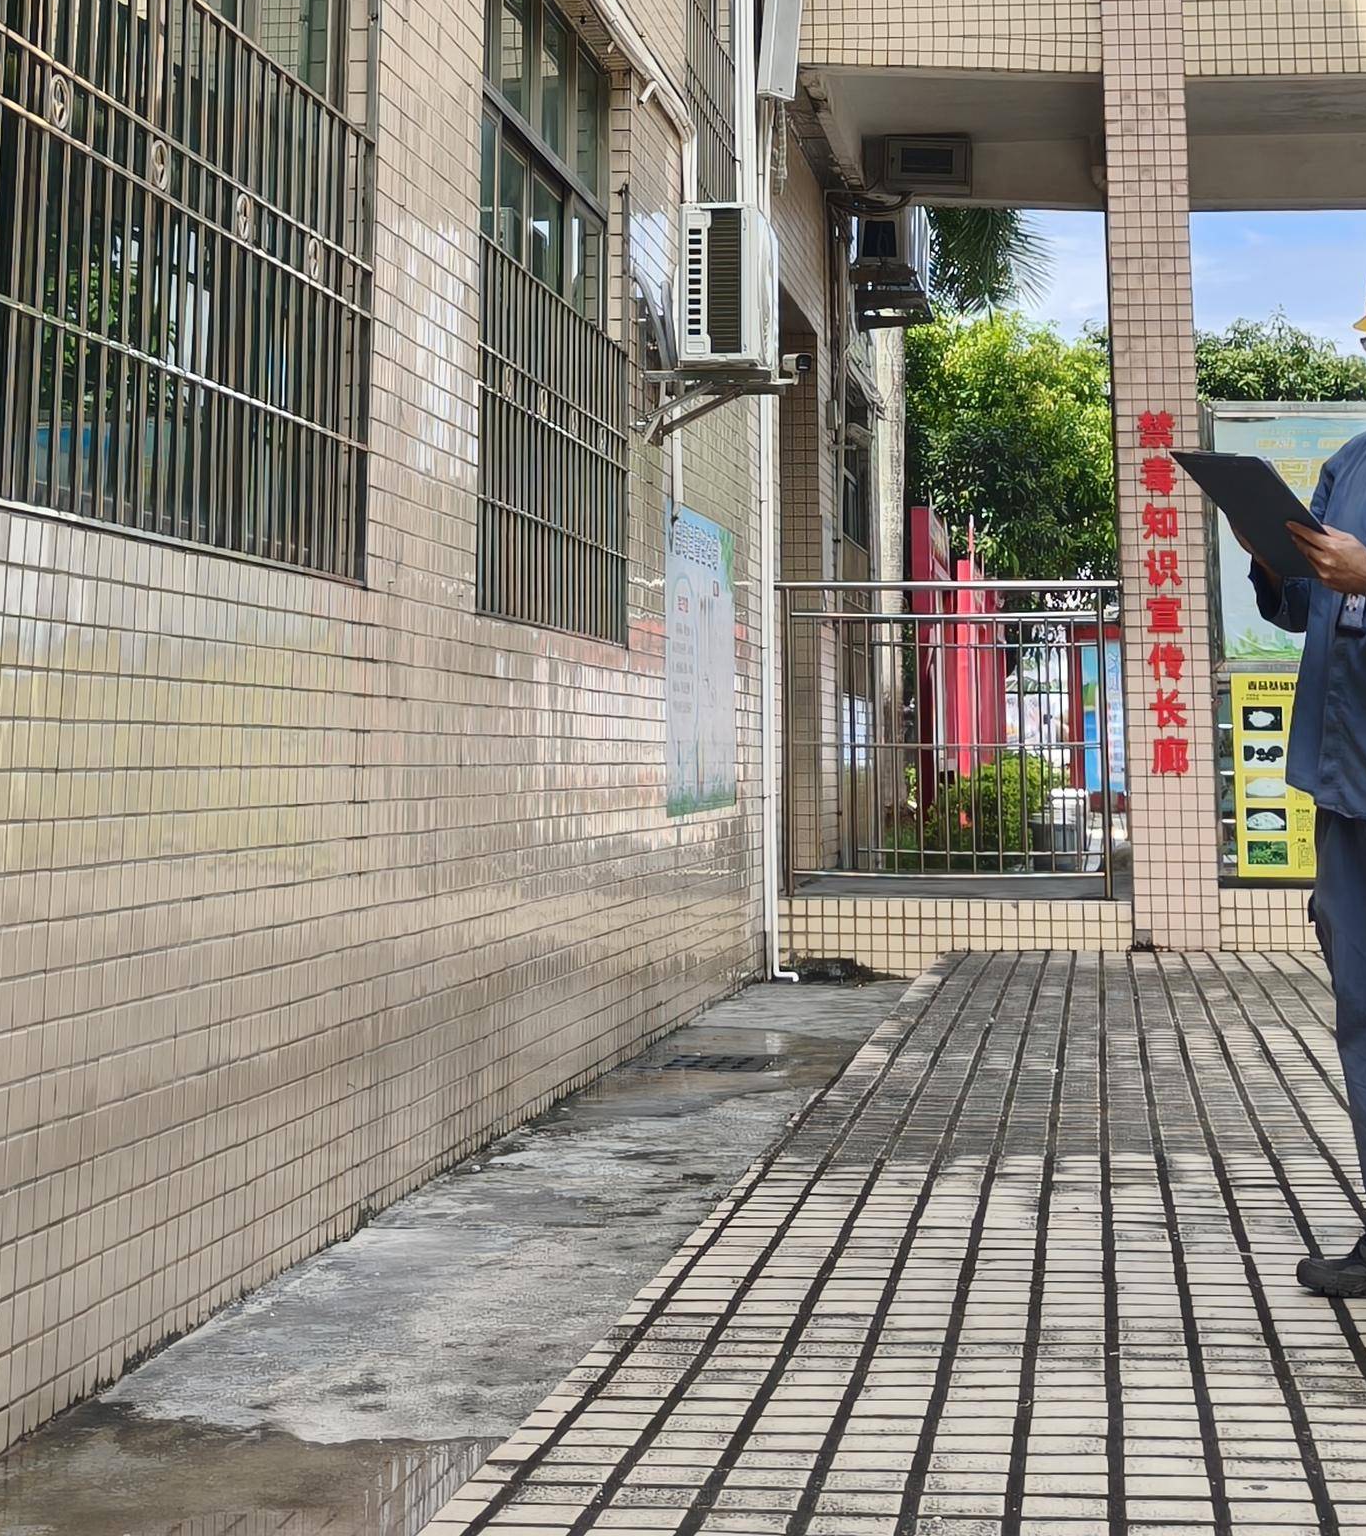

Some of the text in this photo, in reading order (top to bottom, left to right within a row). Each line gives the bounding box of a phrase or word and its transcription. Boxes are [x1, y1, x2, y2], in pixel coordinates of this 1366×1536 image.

[1137, 409, 1189, 777] 禁毒知识宣传长廊
